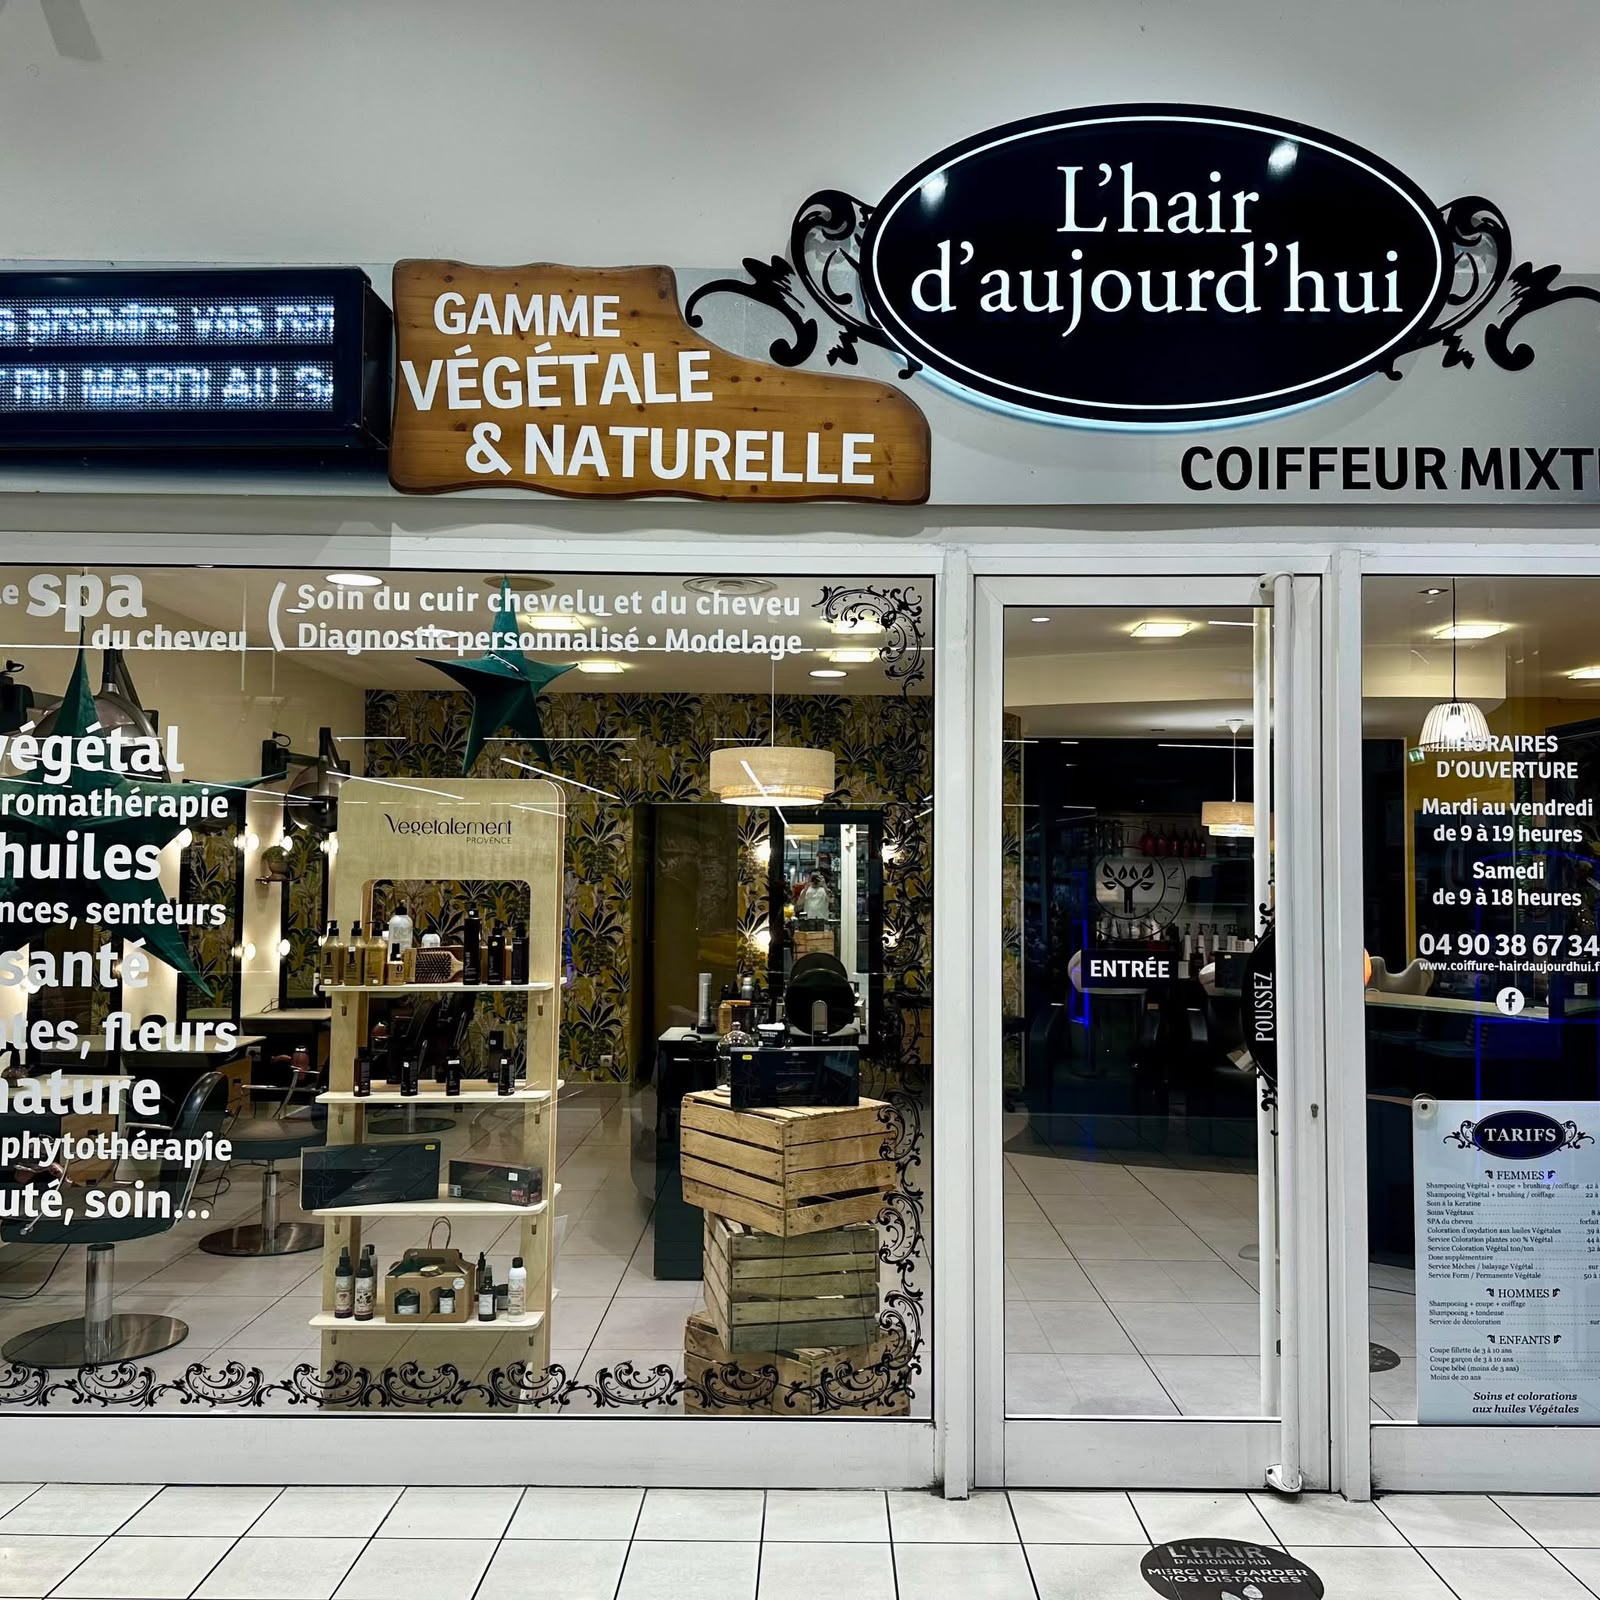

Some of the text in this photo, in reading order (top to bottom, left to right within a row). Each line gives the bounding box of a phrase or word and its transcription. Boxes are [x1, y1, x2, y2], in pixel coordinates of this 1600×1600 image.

[1057, 162, 1260, 235] L’hair
[433, 291, 621, 338] GAMME
[400, 342, 713, 411] VÉGÉTALE
[465, 422, 875, 484] & NATURELLE
[1181, 445, 1600, 492] COIFFEUR MIXT
[0, 572, 147, 632] e spa
[297, 584, 801, 616] Soin du cuir chevelu et du cheveu
[92, 624, 247, 651] du cheveu
[297, 622, 802, 658] Diagnostic personnalisé Modelage
[0, 720, 184, 785] égétal
[1436, 760, 1579, 779] D'OUVERTURE
[1, 786, 229, 825] romathérapie
[1422, 797, 1593, 817] Mardi au vendredi
[384, 813, 512, 836] Vegetalement
[1433, 824, 1583, 843] de 9 à 19 heures
[466, 836, 512, 845] PROVENCE
[0, 830, 162, 880] huiles
[1472, 861, 1544, 880] Samedi
[1433, 887, 1582, 907] de 9 à 18 heures
[85, 899, 227, 926] senteurs
[1419, 933, 1600, 957] 04 90 38 67 34
[0, 937, 149, 988] santé
[1090, 956, 1170, 978] ENTRÉE
[1254, 972, 1275, 1042] POUSSEZ
[0, 1011, 238, 1060] tes, fleurs
[1484, 1128, 1556, 1142] TARIFS
[1, 1130, 233, 1168] phytothérapie
[1497, 1171, 1545, 1180] FEMMES
[1498, 1288, 1550, 1298] HOMMES
[1499, 1335, 1551, 1345] ENFANTS
[1473, 1391, 1578, 1401] Soins et colorations
[1472, 1404, 1579, 1415] aux huiles Végétales
[1166, 1545, 1267, 1559] L'HAIR
[1173, 1558, 1272, 1566] D'AUJOURD'HUI
[1147, 1568, 1309, 1577] MERCI DE GARDER
[1162, 1575, 1302, 1584] VOS DISTANCES
